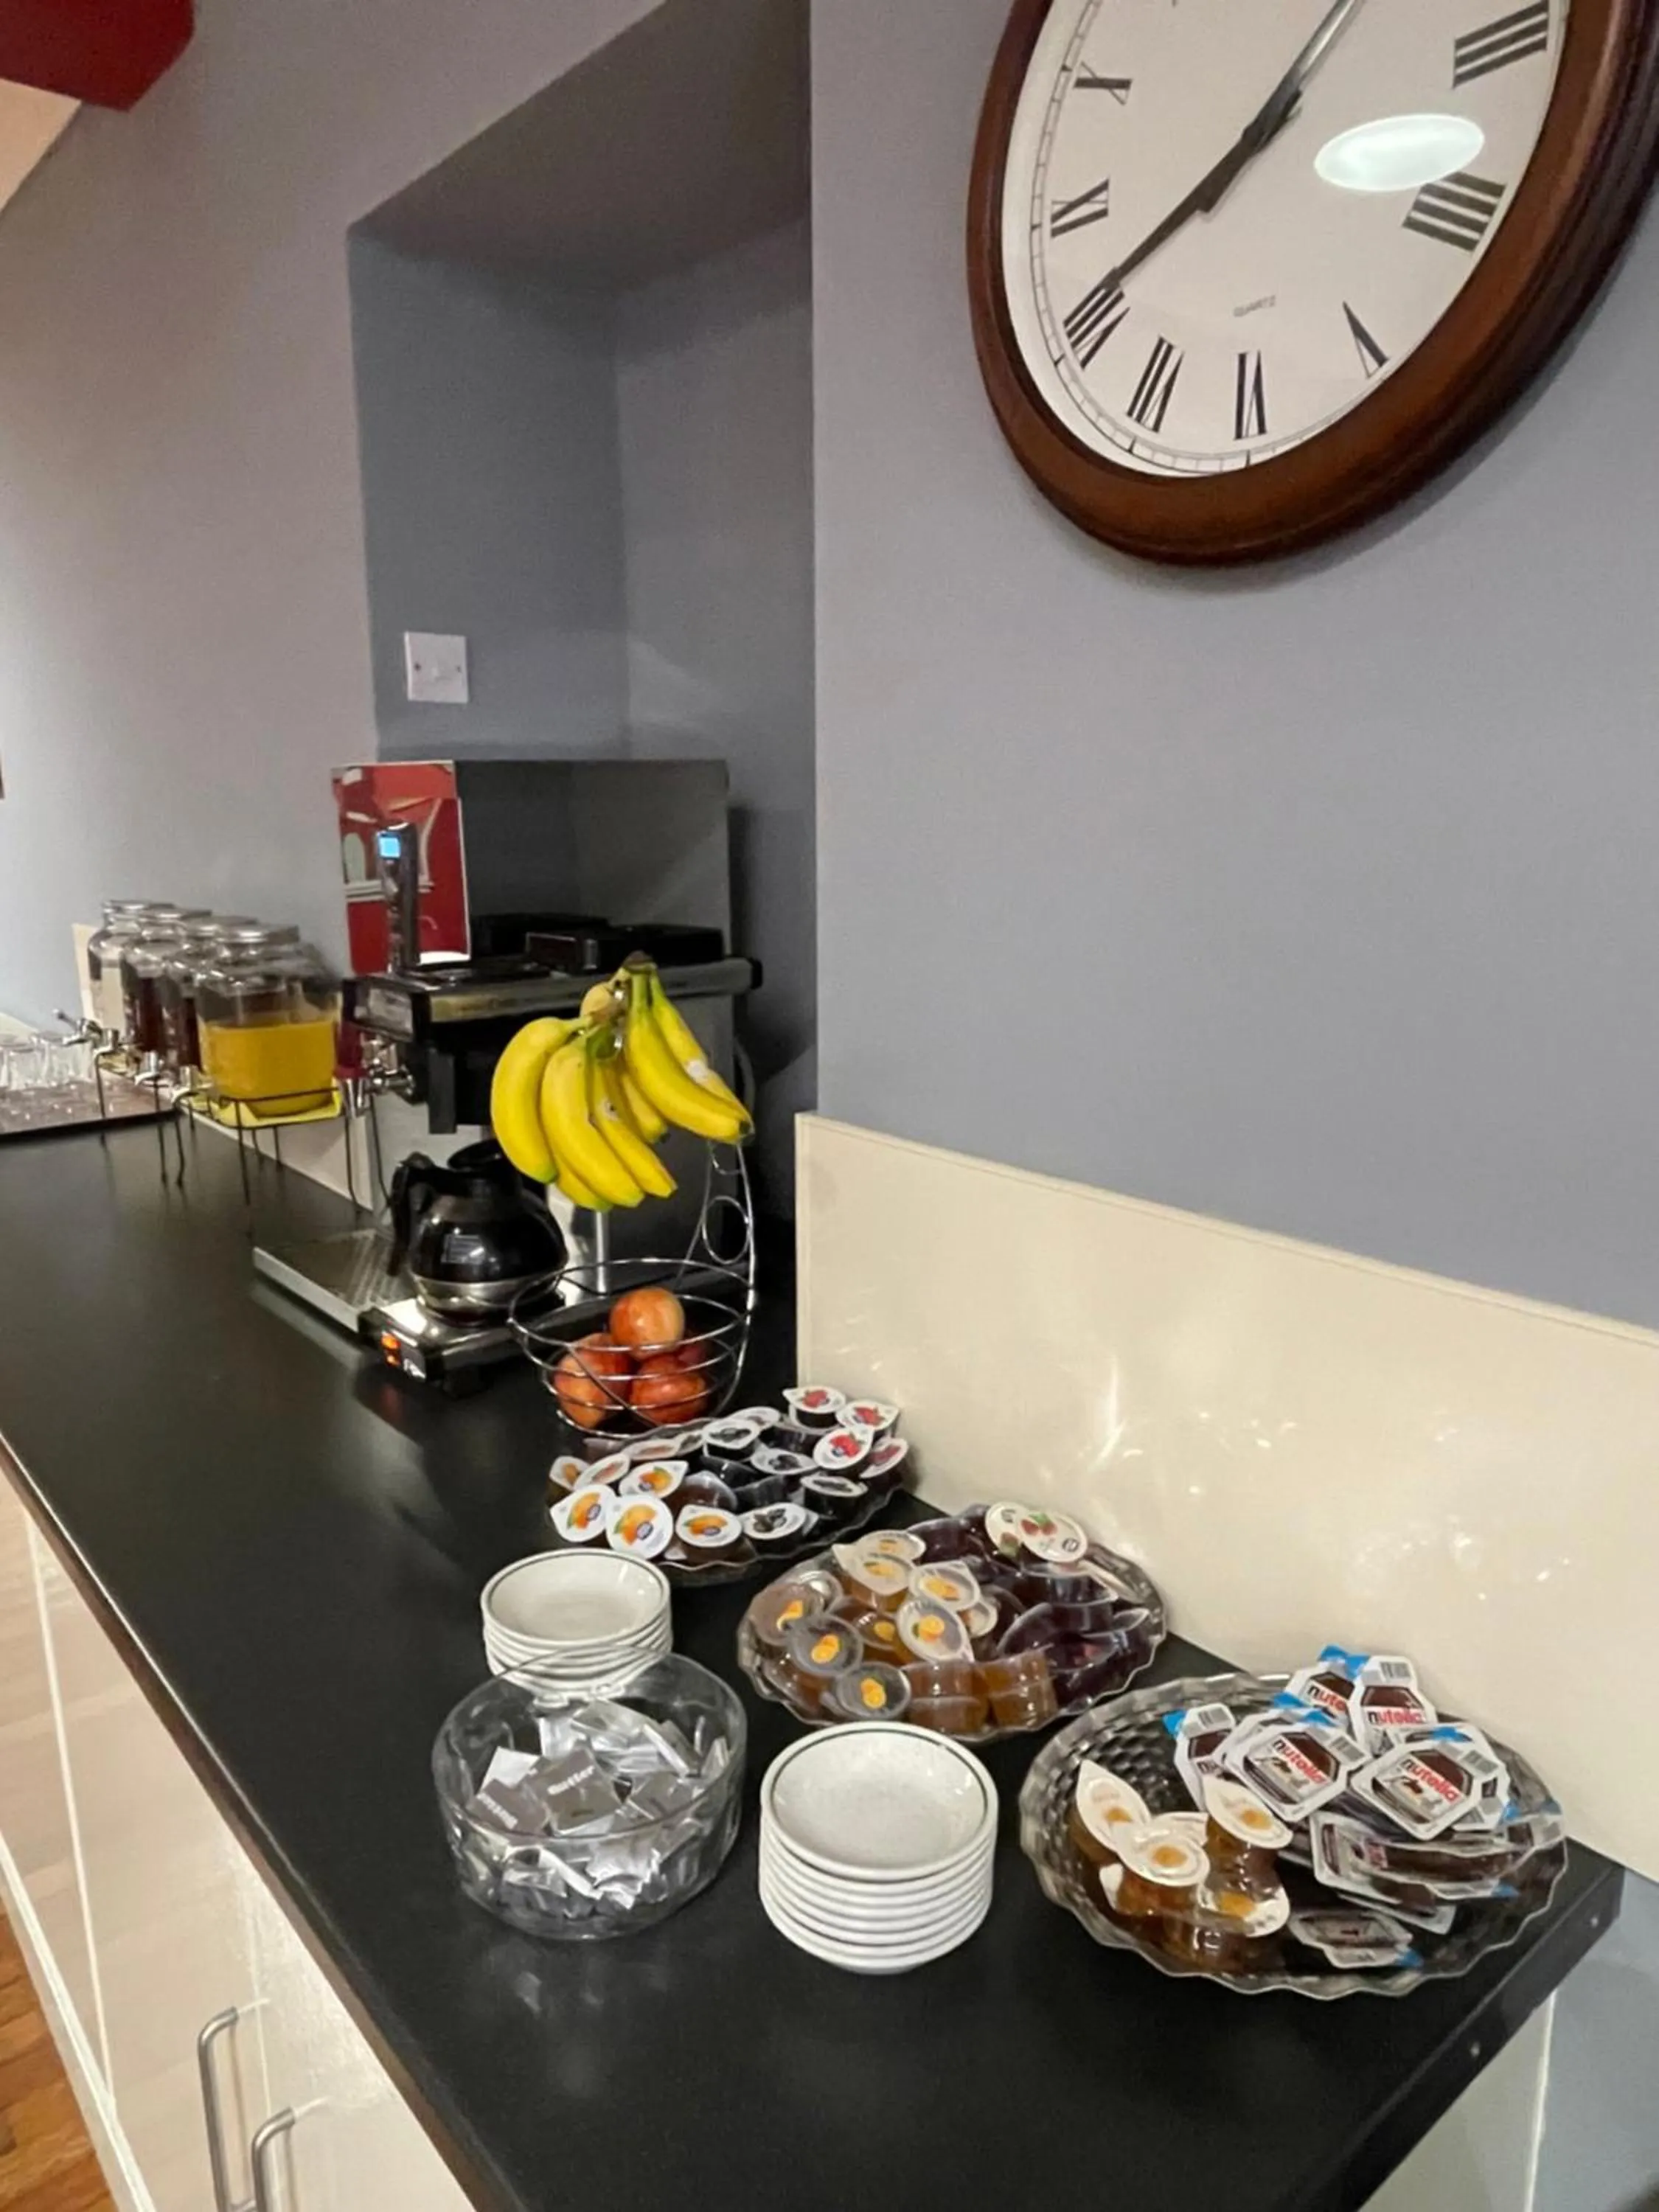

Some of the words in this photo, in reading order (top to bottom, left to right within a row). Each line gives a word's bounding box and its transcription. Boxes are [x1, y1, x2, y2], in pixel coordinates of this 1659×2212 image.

[1073, 60, 1132, 105] X
[1050, 178, 1109, 238] IX
[1343, 301, 1389, 379] V
[1125, 334, 1185, 433] VII
[1234, 349, 1267, 440] VI
[1273, 1738, 1326, 1785] nutella
[1400, 1758, 1460, 1804] nutella
